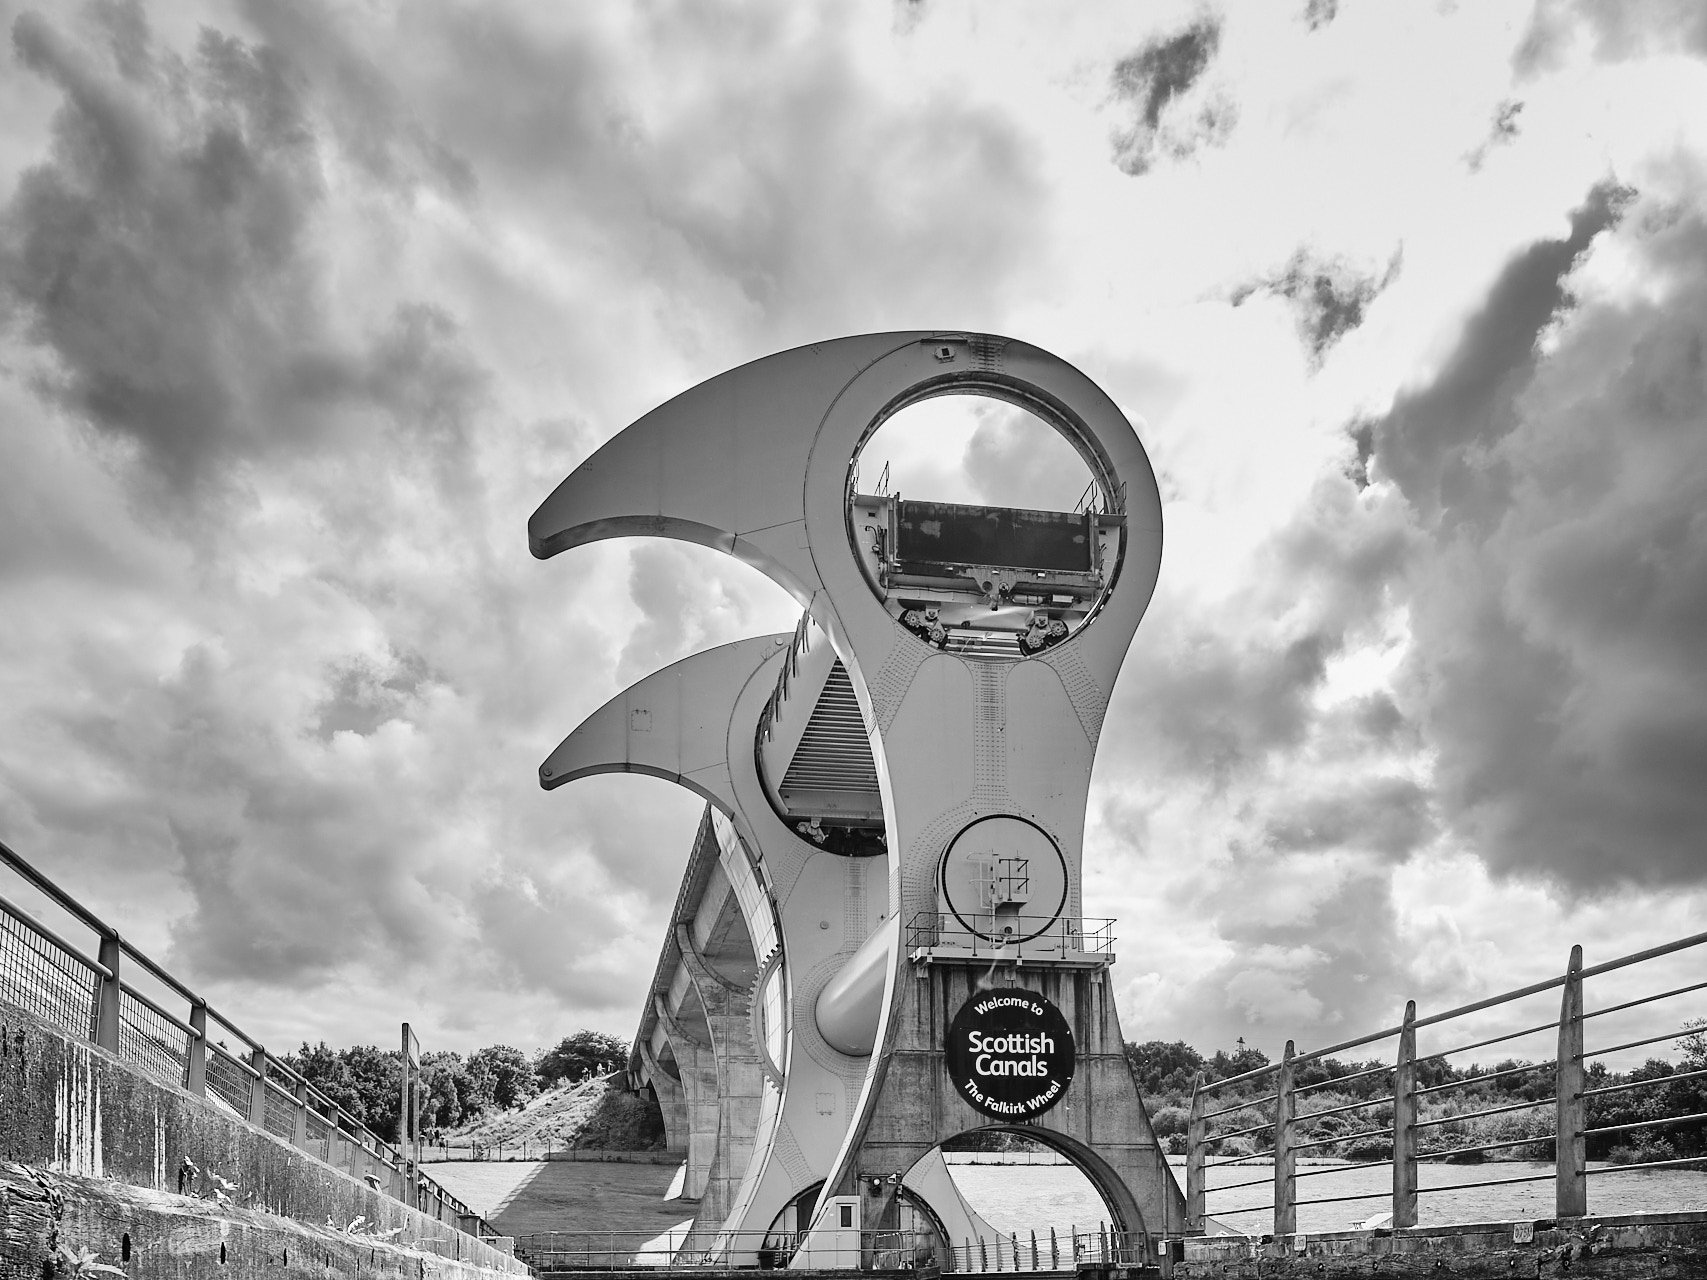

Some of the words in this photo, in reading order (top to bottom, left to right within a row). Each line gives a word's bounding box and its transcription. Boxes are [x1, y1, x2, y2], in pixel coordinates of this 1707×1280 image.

[974, 997, 1029, 1015] Welcome
[1031, 1002, 1044, 1016] to
[968, 1031, 1055, 1054] Scottish
[975, 1053, 1048, 1077] Canals
[964, 1078, 984, 1103] The
[984, 1096, 1027, 1114] Falkirk
[1026, 1079, 1061, 1111] Wheel
